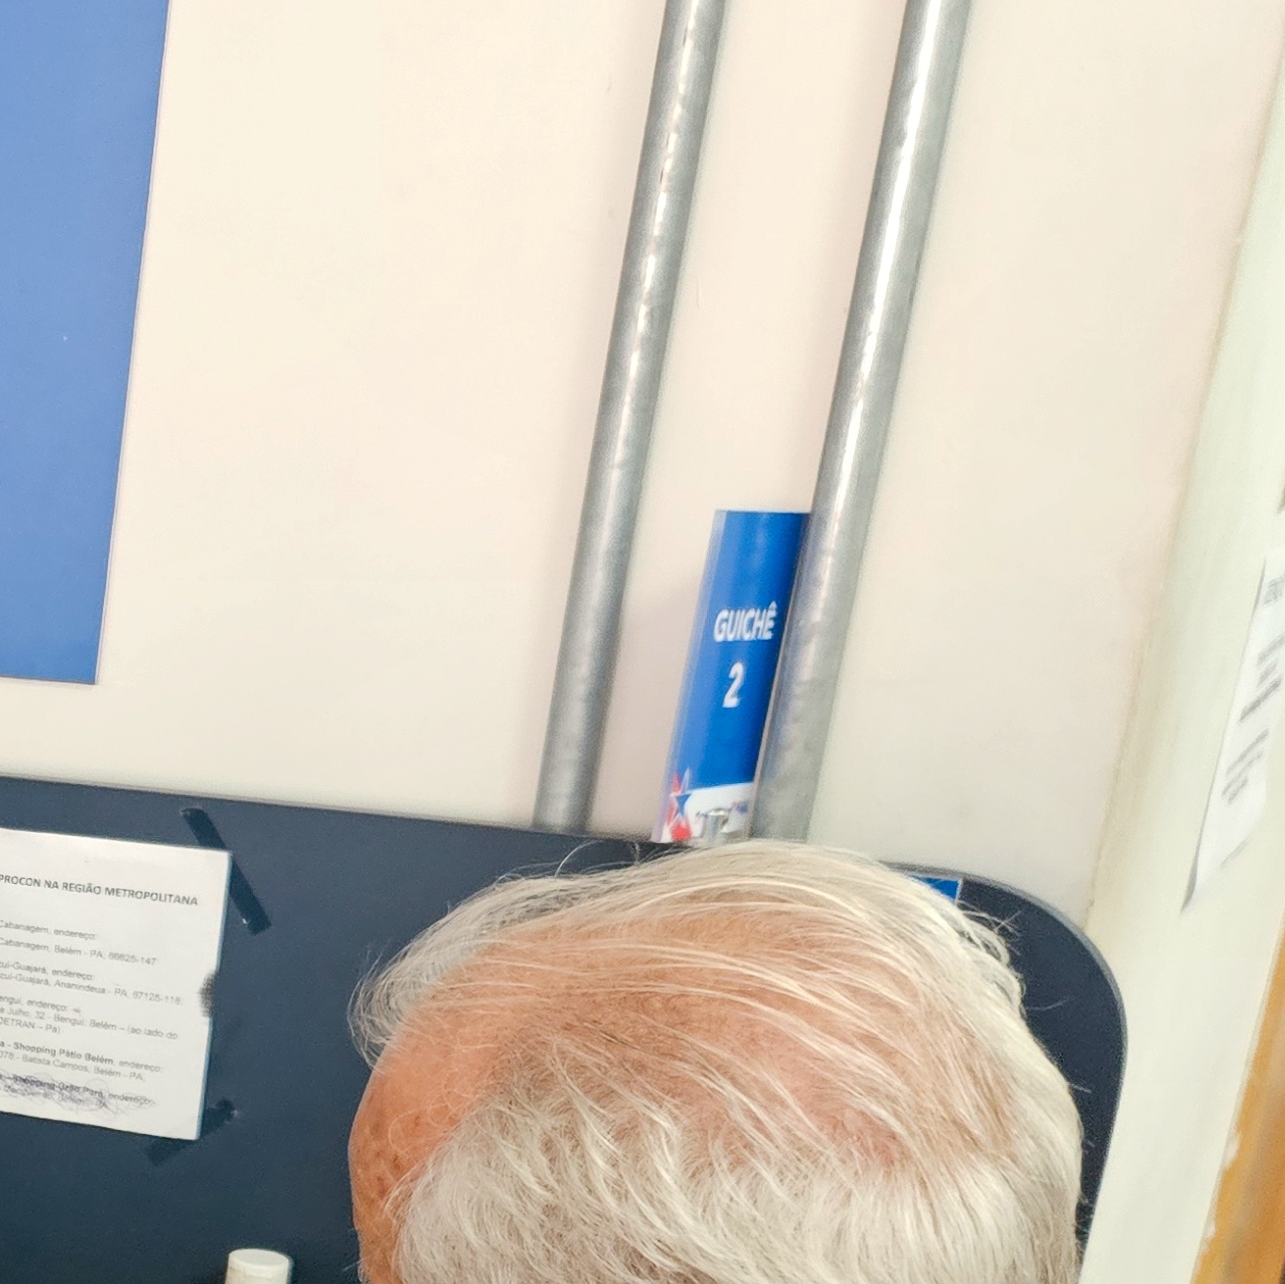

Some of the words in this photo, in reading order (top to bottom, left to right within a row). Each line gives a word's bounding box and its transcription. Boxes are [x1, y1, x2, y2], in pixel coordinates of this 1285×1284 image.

[714, 600, 778, 643] GUICHÊ
[722, 661, 745, 708] 2
[44, 880, 59, 889] NA
[62, 882, 101, 895] REGIÃO
[105, 887, 198, 905] METROPOLITANA
